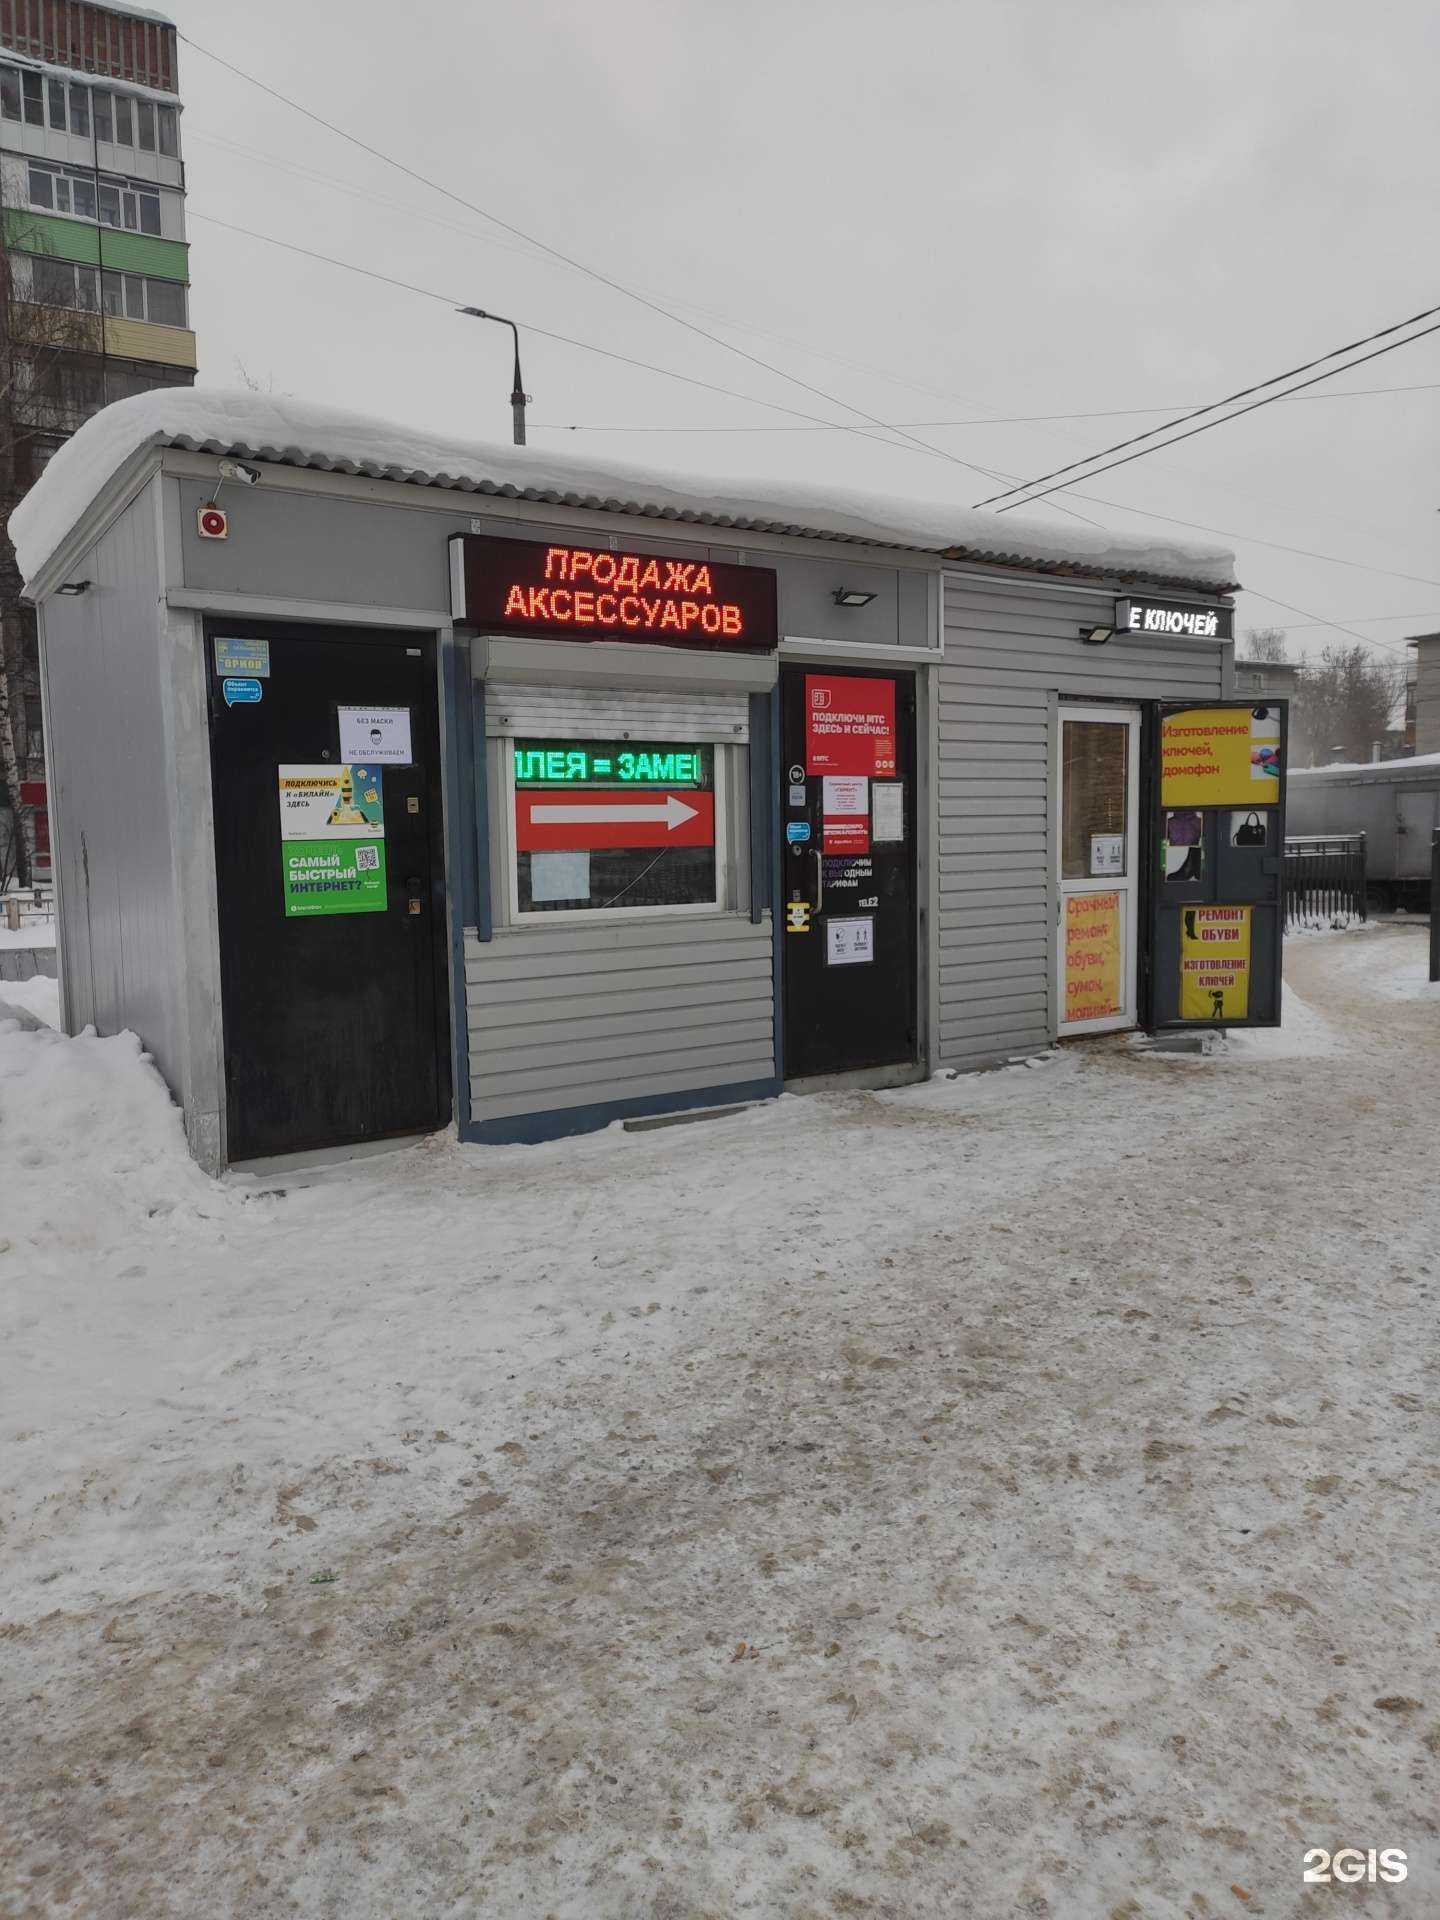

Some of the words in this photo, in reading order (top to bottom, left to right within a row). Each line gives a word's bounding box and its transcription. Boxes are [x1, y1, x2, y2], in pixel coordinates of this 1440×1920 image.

[545, 548, 712, 594] ПРОДАЖА
[504, 585, 743, 634] АКСЕССУАРОВ
[1144, 610, 1219, 636] КЛЮЧЕЙ
[812, 712, 865, 723] ПОДКЛЮЧИ
[866, 715, 885, 724] МТС
[812, 723, 843, 734] ЗДЕСЬ
[844, 725, 850, 733] И
[852, 724, 890, 735] СЕЙЧАС!
[1162, 726, 1248, 737] Изготовление
[1162, 742, 1213, 757] ключей,
[617, 752, 697, 780] ЗАМЕ
[1163, 764, 1220, 777] домофон
[285, 779, 338, 788] ПОДКЛЮЧИСЬ
[289, 854, 340, 867] САМЫЙ
[289, 867, 357, 880] БЫСТРЫЙ
[290, 880, 361, 893] ИНТЕРНЕТ?
[859, 897, 878, 907] TELE2
[1067, 893, 1119, 917] Срочный
[1199, 909, 1243, 921] РЕМОНТ
[1067, 924, 1109, 945] ремонт
[1202, 928, 1239, 940] ОБУВИ
[1184, 960, 1246, 970] ИЗГОТОВЛЕНИЕ
[1199, 975, 1235, 986] КЛЮЧЕЙ
